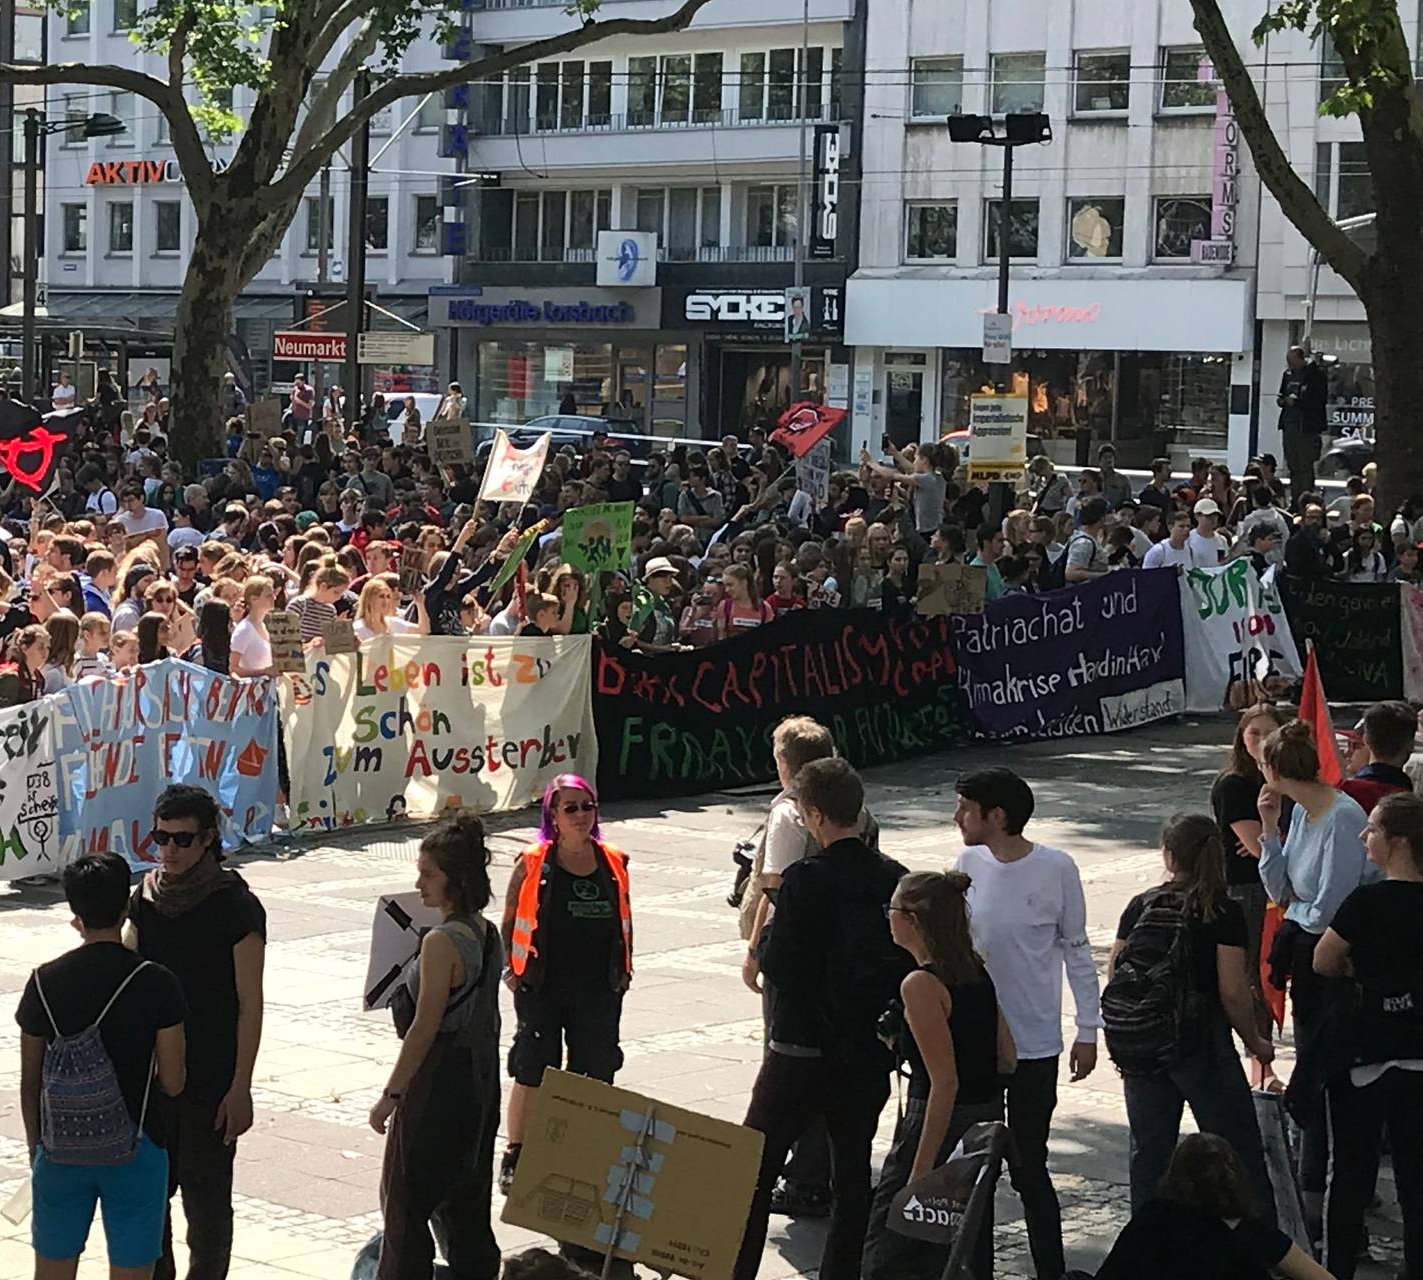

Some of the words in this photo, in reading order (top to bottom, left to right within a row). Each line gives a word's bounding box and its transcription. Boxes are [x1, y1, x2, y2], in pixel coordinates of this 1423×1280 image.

[36, 290, 46, 305] 4
[274, 337, 347, 357] Neumarkt
[1351, 396, 1374, 408] PRE
[1332, 412, 1375, 424] SUMM
[356, 651, 441, 697] Leben
[461, 646, 506, 687] ist
